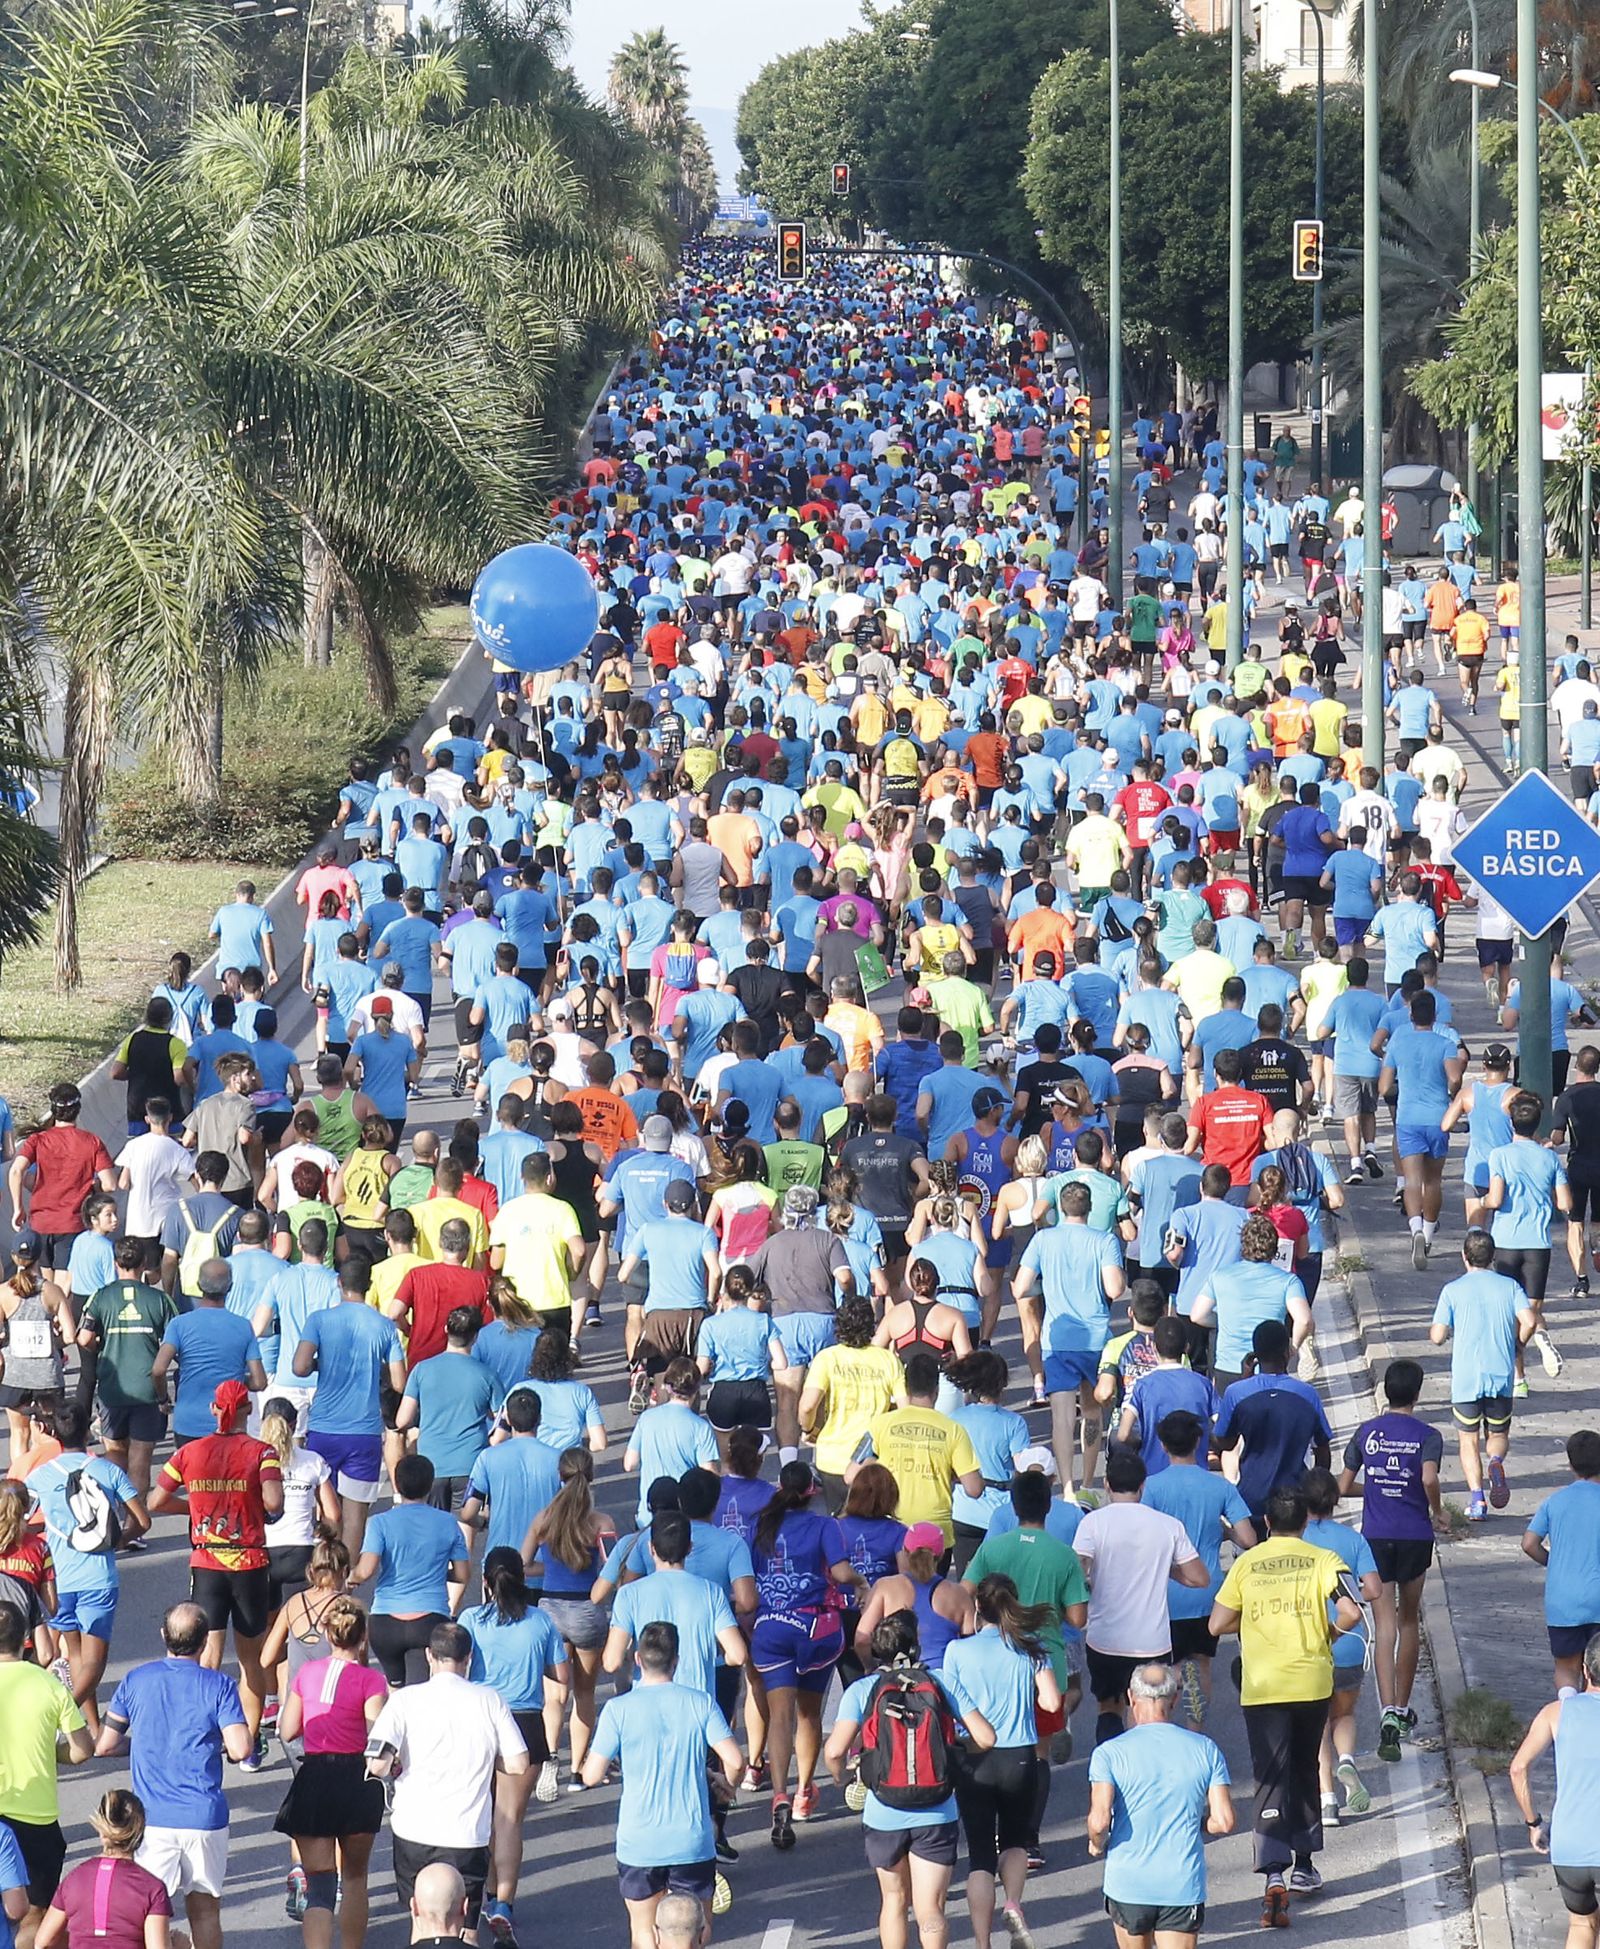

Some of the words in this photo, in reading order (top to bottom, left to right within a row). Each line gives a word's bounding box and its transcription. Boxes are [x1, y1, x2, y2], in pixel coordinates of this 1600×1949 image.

[1360, 804, 1383, 831] 18
[1505, 829, 1561, 850] RED
[1482, 851, 1584, 877] BÁSICA
[858, 1157, 899, 1168] FINISHER
[973, 1151, 993, 1163] RCM
[972, 1164, 993, 1174] 1873
[889, 1425, 947, 1440] CASTILLO
[1251, 1557, 1315, 1574] CASTILLO
[1251, 1600, 1264, 1622] El
